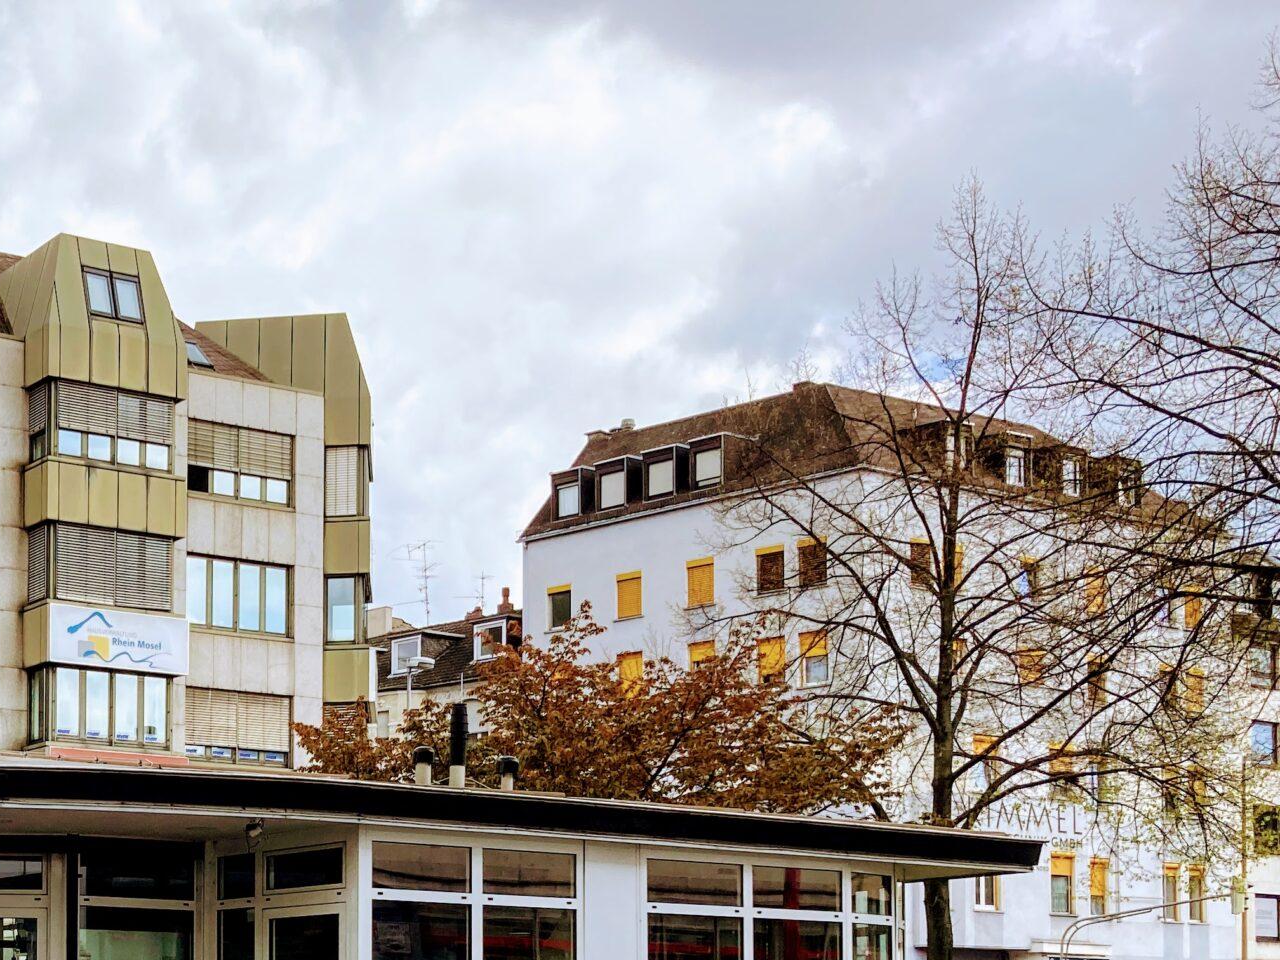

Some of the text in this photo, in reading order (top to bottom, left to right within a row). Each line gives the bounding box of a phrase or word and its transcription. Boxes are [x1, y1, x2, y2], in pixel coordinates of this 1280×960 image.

[112, 637, 162, 650] Rhein Mosel
[1051, 836, 1083, 849] GMBH
